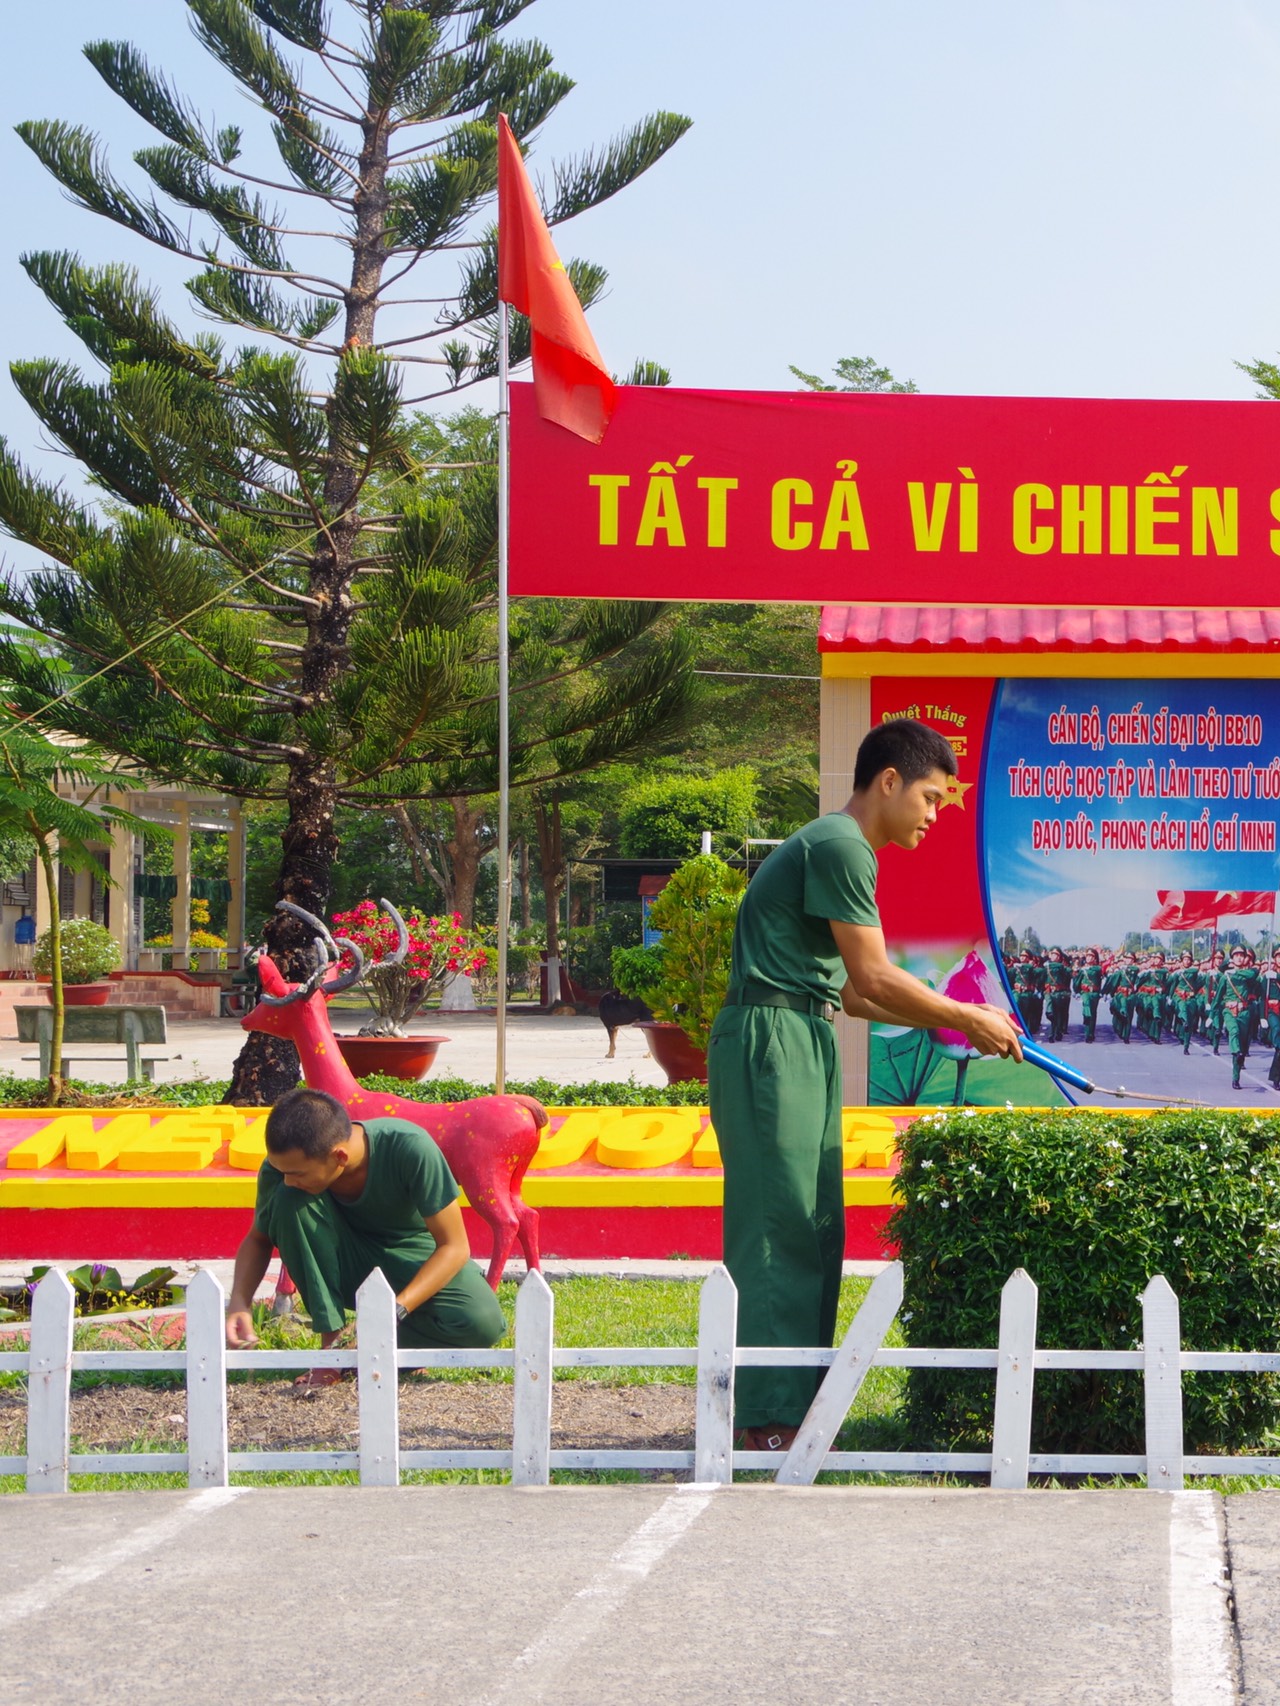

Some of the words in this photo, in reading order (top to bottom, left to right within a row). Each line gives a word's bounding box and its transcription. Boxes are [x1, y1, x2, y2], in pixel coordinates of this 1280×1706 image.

[589, 455, 738, 547] TẤT
[771, 459, 869, 551] CẢ
[907, 467, 978, 552] VÌ
[1012, 465, 1239, 557] CHIẾN
[925, 704, 968, 728] Thắng
[1048, 705, 1077, 744] CÁN
[1081, 705, 1104, 751] BỘ,
[1107, 702, 1149, 744] CHIẾN
[1152, 706, 1169, 745] SĨ
[1170, 714, 1194, 751] ĐẠI
[1197, 707, 1221, 751] ĐỘI
[1225, 715, 1262, 745] BB10
[1008, 758, 1040, 797] TÍCH
[1044, 761, 1072, 803] CỰC
[1076, 766, 1104, 803] HỌC
[1107, 759, 1136, 803] TẬP
[1138, 759, 1157, 798] VÀ
[1160, 759, 1190, 798] LÀM
[1194, 768, 1229, 798] THEO
[1232, 762, 1254, 799] TƯ
[1033, 820, 1062, 855] ĐẠO
[1065, 811, 1097, 855] ĐỨC,
[1101, 821, 1146, 850] PHONG
[1150, 812, 1186, 851] CÁCH
[1190, 808, 1210, 851] HỒ
[1213, 813, 1238, 851] CHÍ
[1240, 821, 1276, 852] MINH
